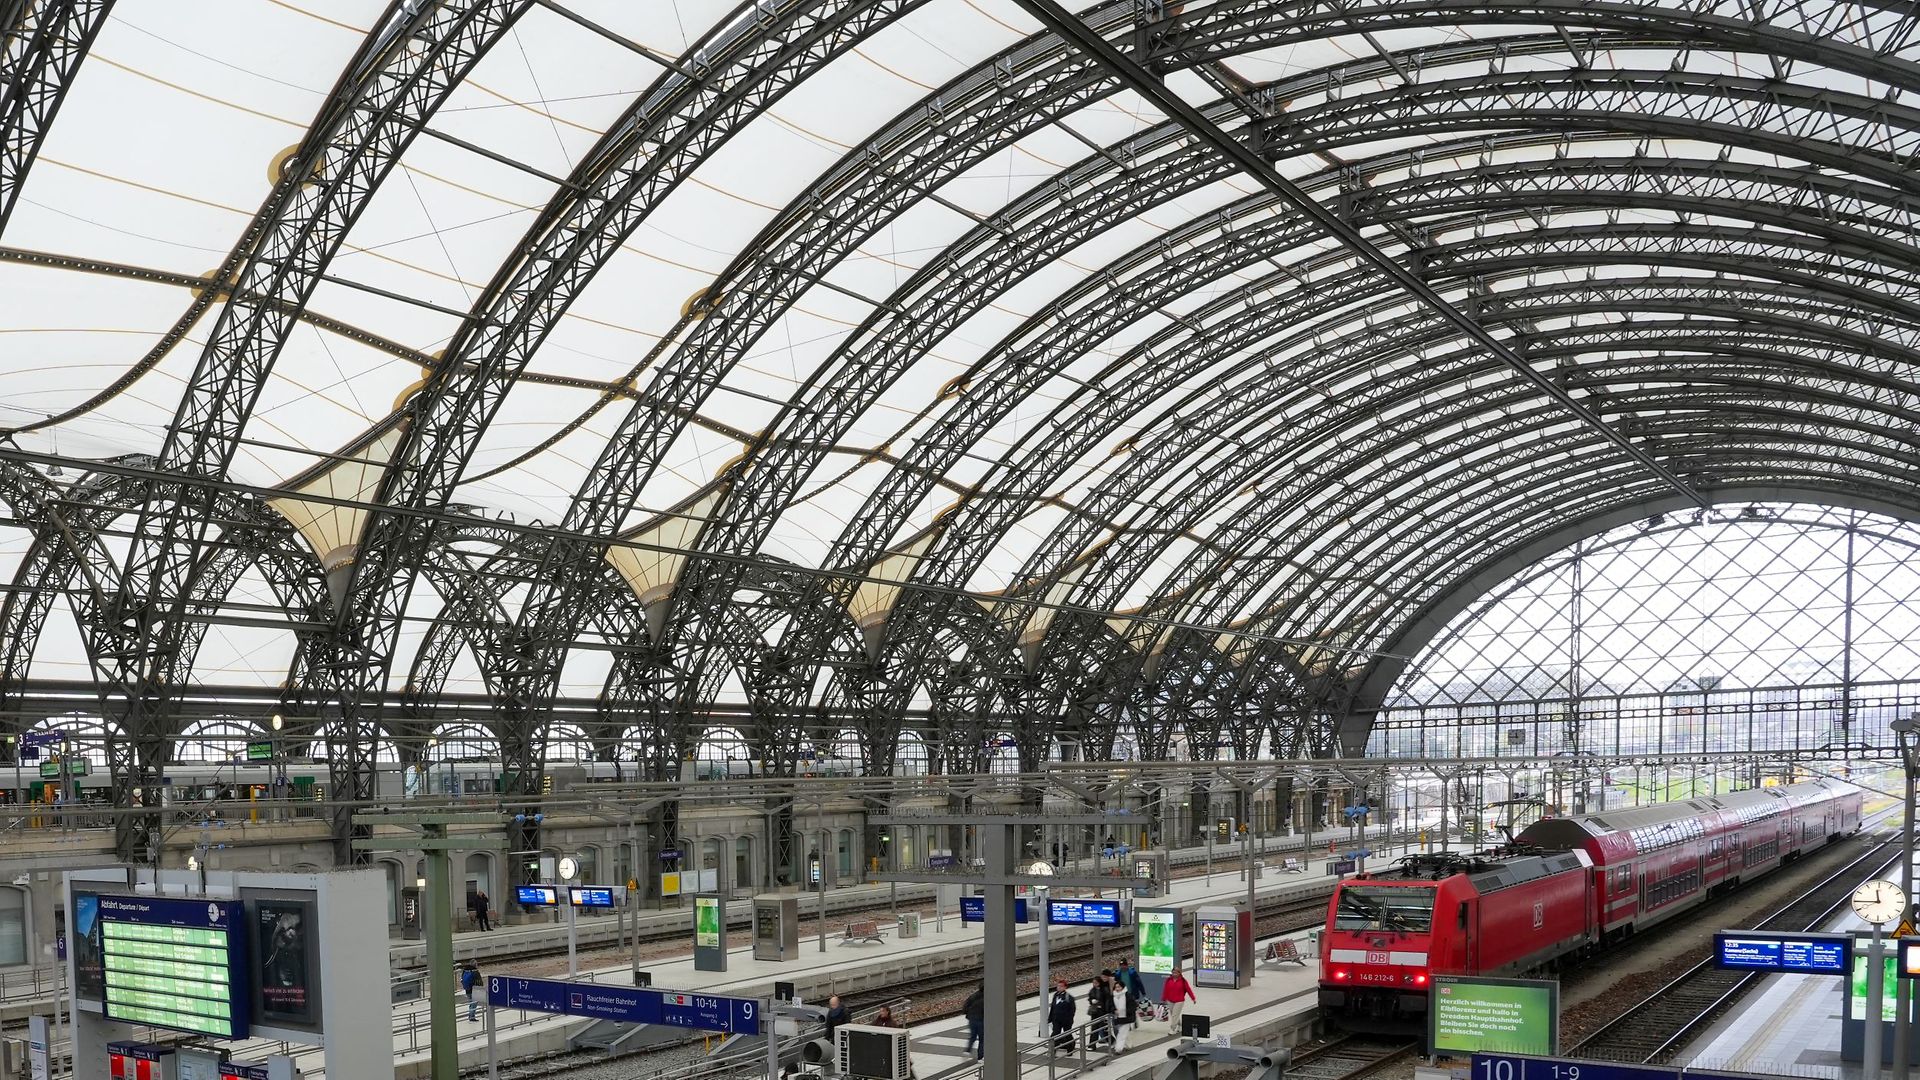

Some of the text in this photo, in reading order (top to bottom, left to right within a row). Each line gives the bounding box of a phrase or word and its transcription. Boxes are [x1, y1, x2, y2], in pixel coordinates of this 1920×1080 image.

[18, 734, 24, 744] 3
[101, 900, 118, 909] Abfahrt
[59, 938, 63, 949] 6
[492, 978, 499, 993] 8
[518, 981, 528, 990] 1-7
[587, 995, 615, 1004] Rauchfreier
[696, 998, 717, 1009] 10-14
[1471, 1000, 1513, 1009] willkommen
[587, 1005, 612, 1014] Non-Smoking
[743, 1002, 753, 1019] 9
[1440, 1005, 1476, 1013] Elbflorenz
[1471, 1014, 1524, 1024] Hauptbahnhof.
[1452, 1028, 1485, 1036] bisschen.
[1480, 1059, 1514, 1080] 10
[1551, 1065, 1580, 1080] 1-9
